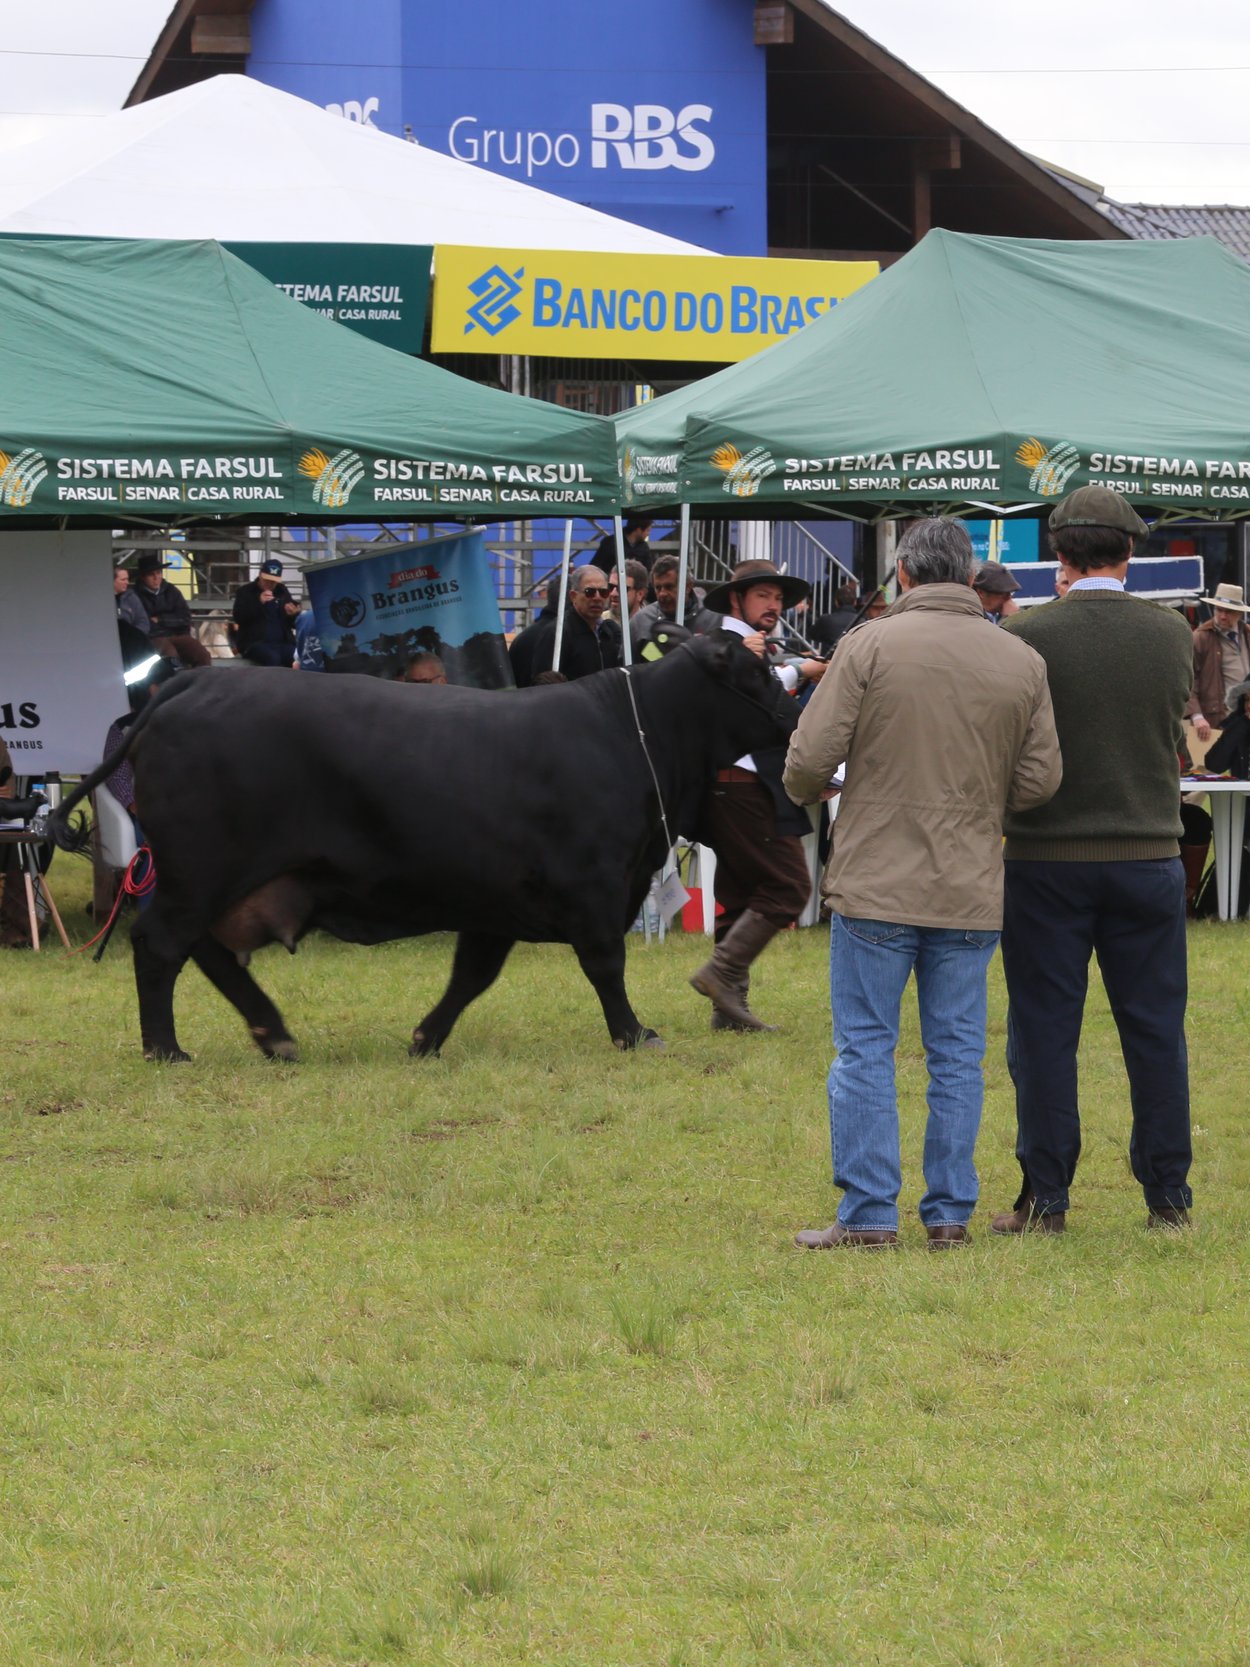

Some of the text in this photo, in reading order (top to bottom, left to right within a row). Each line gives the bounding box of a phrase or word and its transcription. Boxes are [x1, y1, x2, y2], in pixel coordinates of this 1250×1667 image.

[449, 103, 715, 177] Grupo RBS
[337, 285, 404, 303] FARSUL
[339, 309, 366, 319] CASA
[368, 310, 402, 320] RURAL
[532, 277, 667, 332] BANCO
[674, 291, 723, 334] DO
[57, 457, 283, 479] SISTEMA FARSUL
[373, 459, 592, 484] SISTEMA FARSUL
[785, 449, 1000, 474] SISTEMA FARSUL
[1089, 453, 1199, 477] SISTEMA
[58, 485, 284, 501] FARSUL SENAR CASA RURAL
[783, 477, 1000, 491] FARSUL SENAR CASA RURAL
[1152, 483, 1202, 497] SENAR
[1210, 486, 1250, 499] CASA
[374, 487, 594, 503] FARSUL SENAR CASA RURAL
[398, 567, 428, 581] dia do
[371, 579, 460, 610] Brangus
